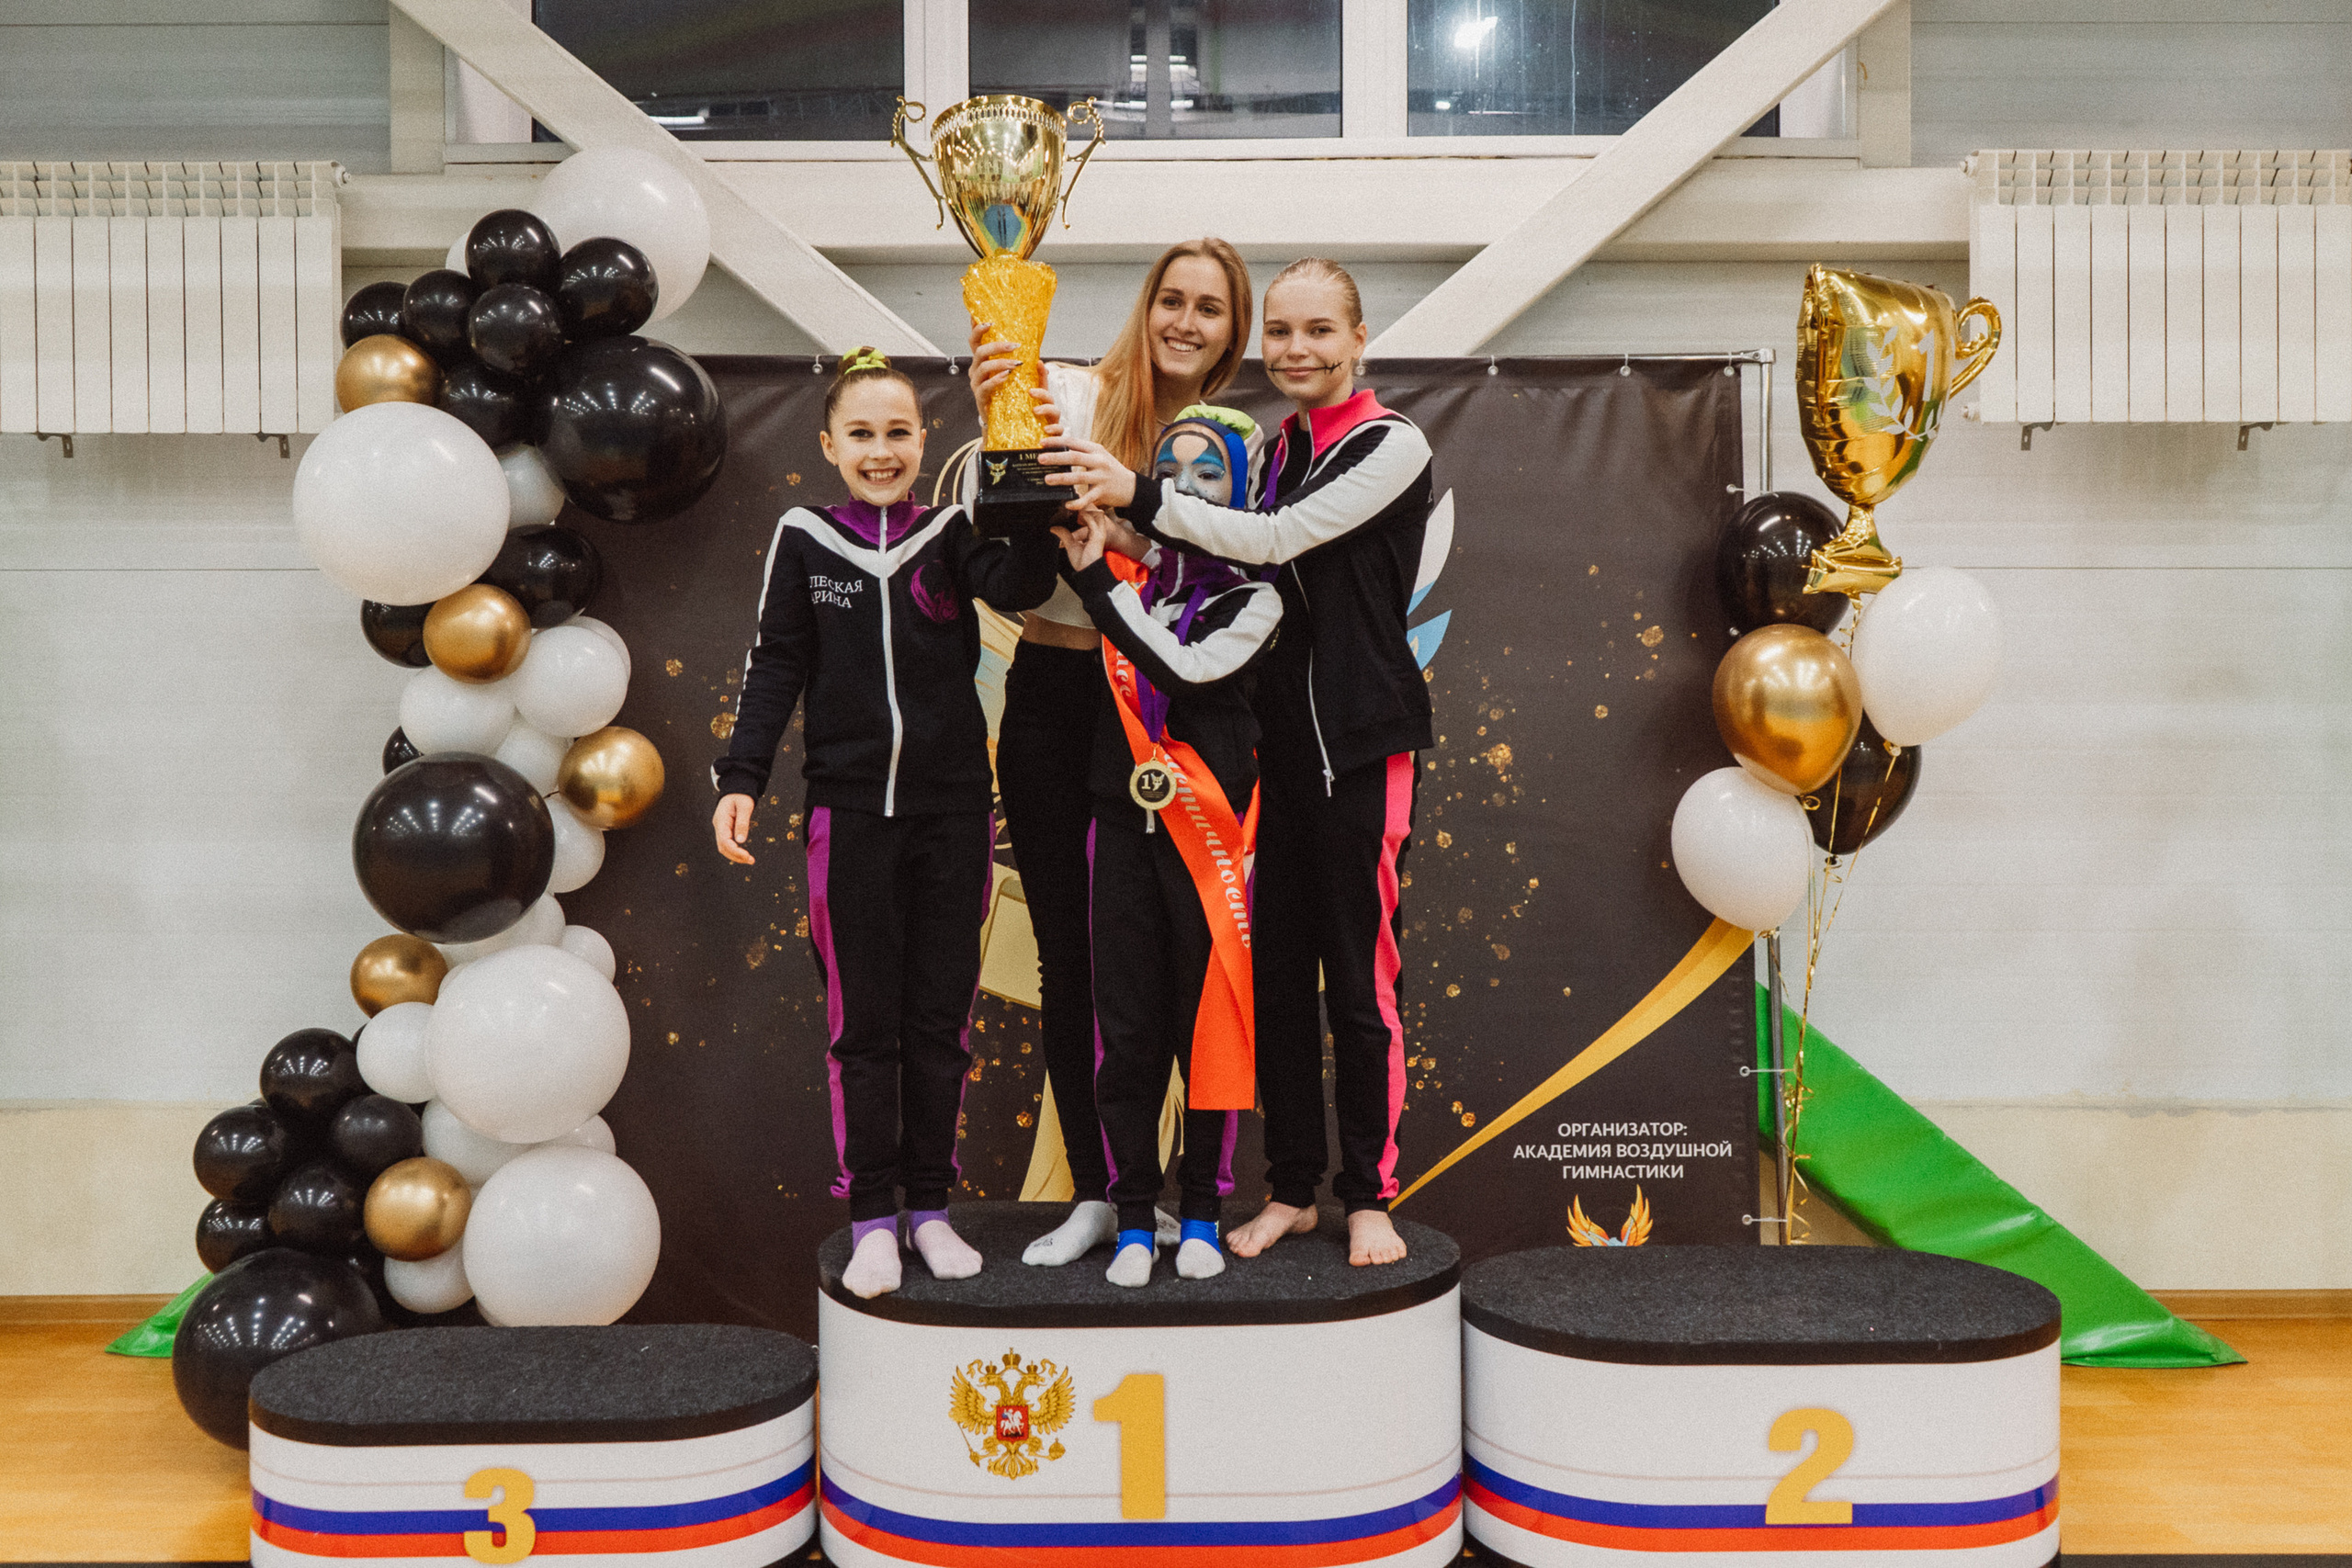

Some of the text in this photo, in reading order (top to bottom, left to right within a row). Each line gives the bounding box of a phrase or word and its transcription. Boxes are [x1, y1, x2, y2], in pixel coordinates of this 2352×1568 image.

[1918, 329, 1934, 401] 1
[809, 575, 864, 593] ЛЕСКАЯ
[1141, 774, 1151, 790] 1
[1557, 1122, 1688, 1137] ОРГАНИЗАТОР:
[1513, 1141, 1733, 1161] АКАДЕМИЯ ВОЗДУШНОЙ
[1563, 1165, 1684, 1179] ГИМНАСТИКИ
[1092, 1373, 1166, 1520] 1
[1765, 1407, 1855, 1525] 2
[464, 1468, 536, 1565] 3
